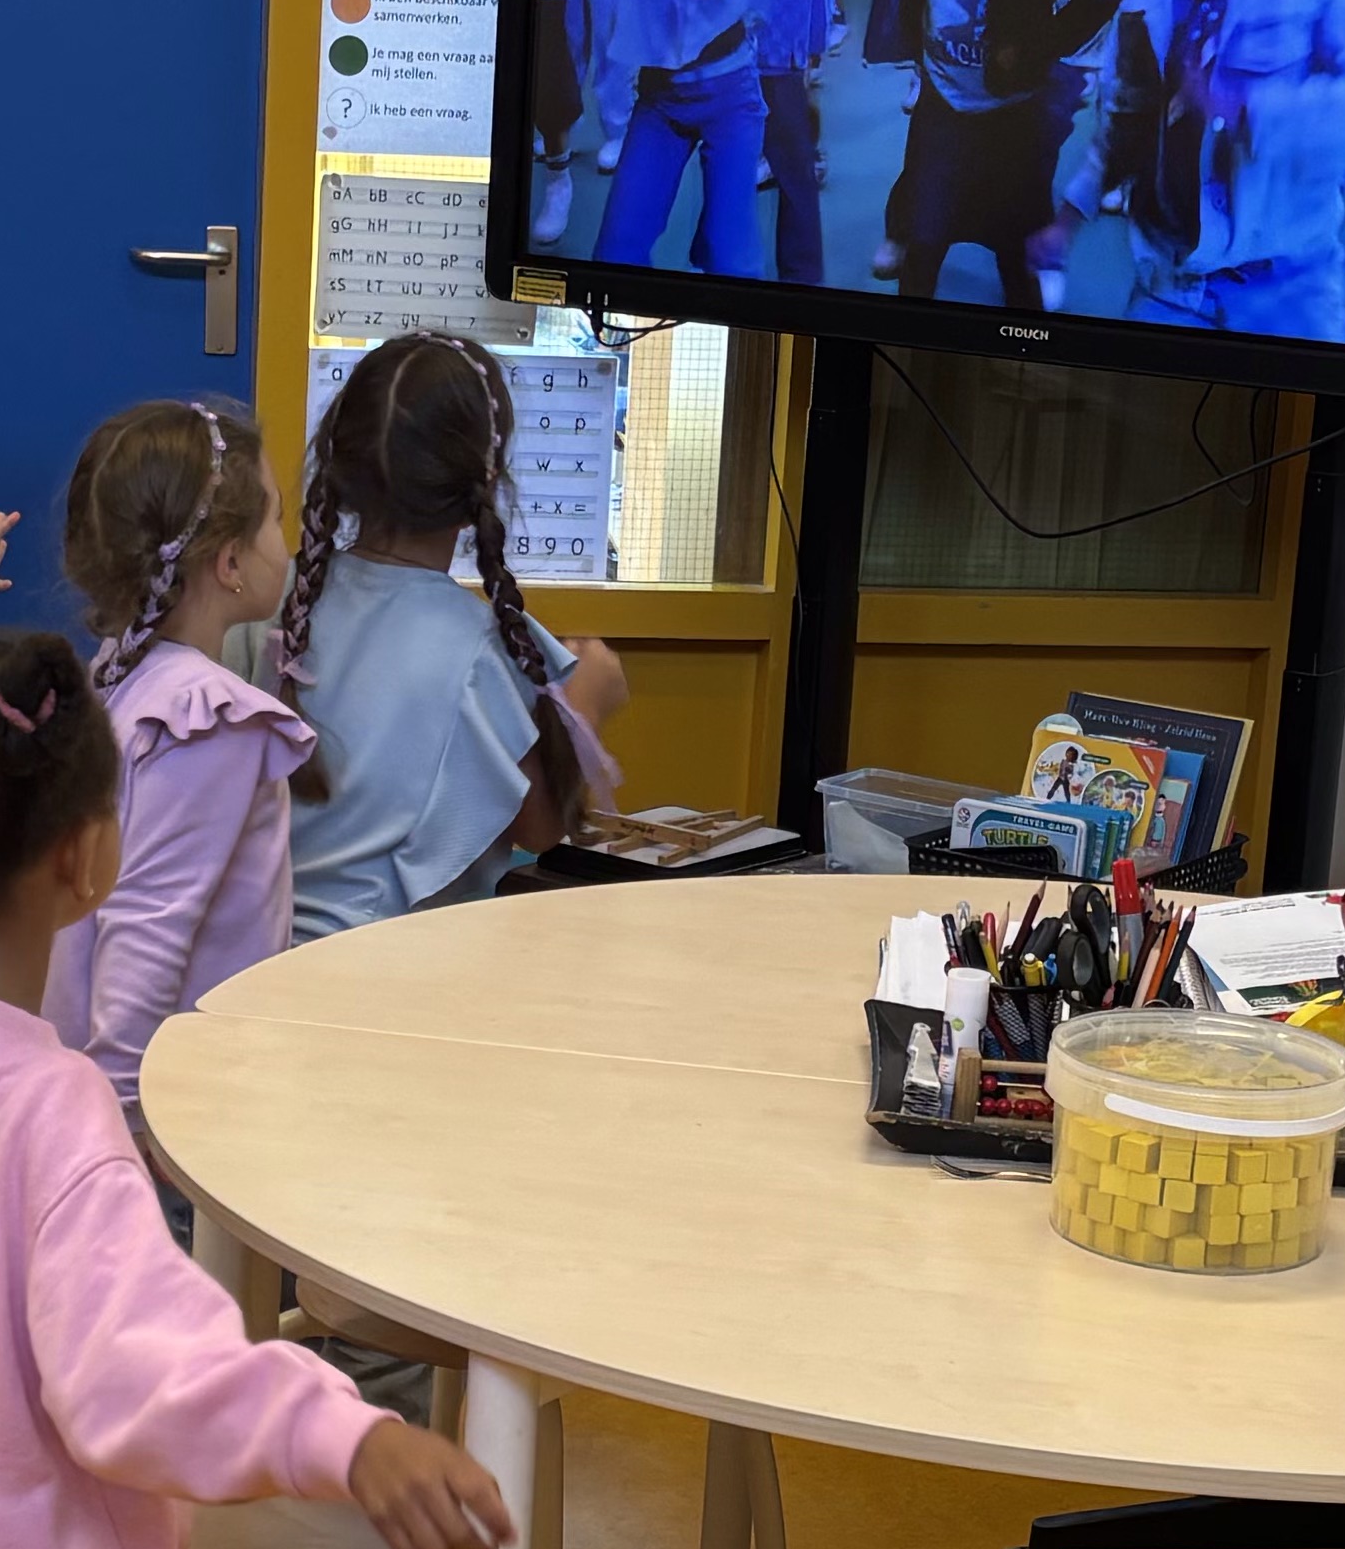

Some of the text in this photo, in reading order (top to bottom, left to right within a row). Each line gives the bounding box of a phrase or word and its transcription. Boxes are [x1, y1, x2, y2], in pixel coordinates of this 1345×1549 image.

[373, 11, 463, 25] samenwerken.
[372, 47, 384, 59] Je
[387, 51, 414, 63] mag
[417, 51, 440, 62] een
[442, 53, 476, 65] vraag
[371, 66, 437, 81] mij stellen.
[341, 98, 353, 119] ?
[370, 104, 472, 121] Ik heb een vraag.
[999, 326, 1049, 341] CTOUCH
[543, 368, 588, 392] g h
[575, 417, 586, 434] p
[517, 537, 529, 554] 8
[544, 537, 556, 553] 9
[1012, 815, 1076, 834] TRAVEL GAME
[982, 828, 1049, 847] TURTLE
